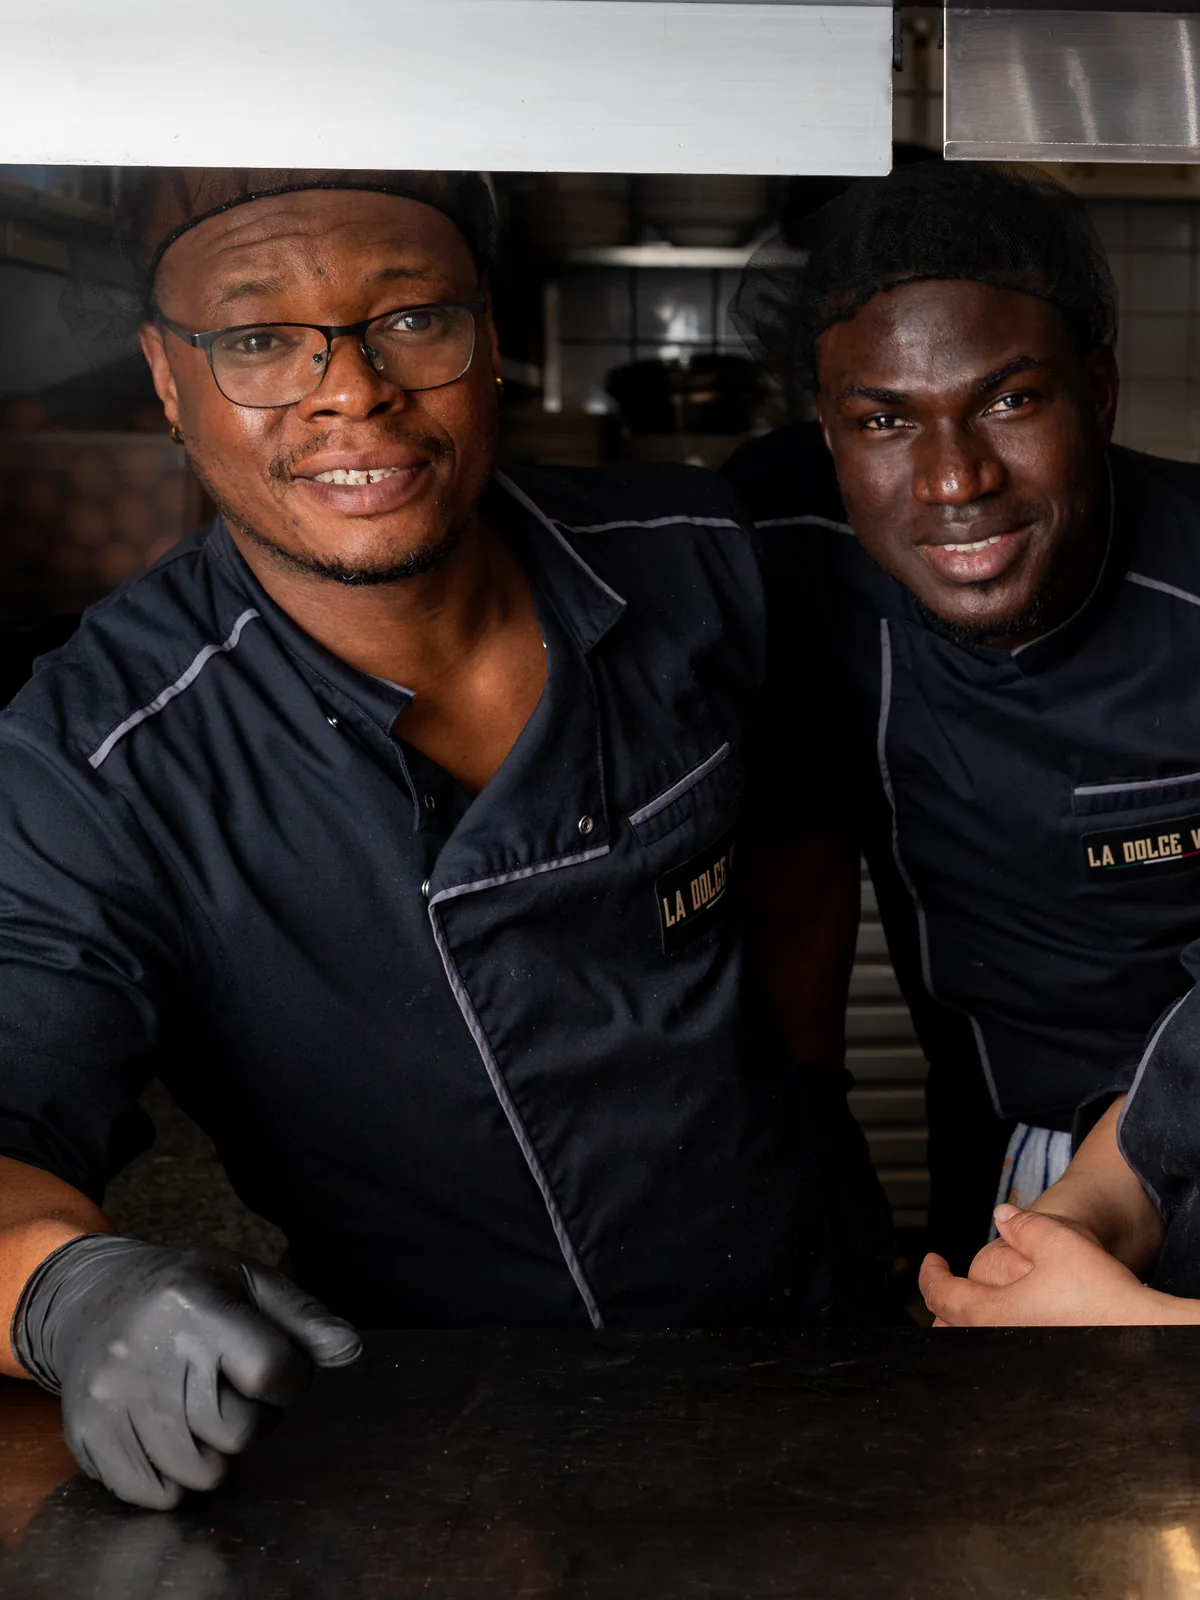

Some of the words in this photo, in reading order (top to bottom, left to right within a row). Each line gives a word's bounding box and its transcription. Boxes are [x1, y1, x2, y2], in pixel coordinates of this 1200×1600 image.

[1087, 845, 1115, 868] LA
[1123, 833, 1182, 863] DOLCE
[663, 889, 686, 928] LA
[690, 856, 726, 910] DOLCE
